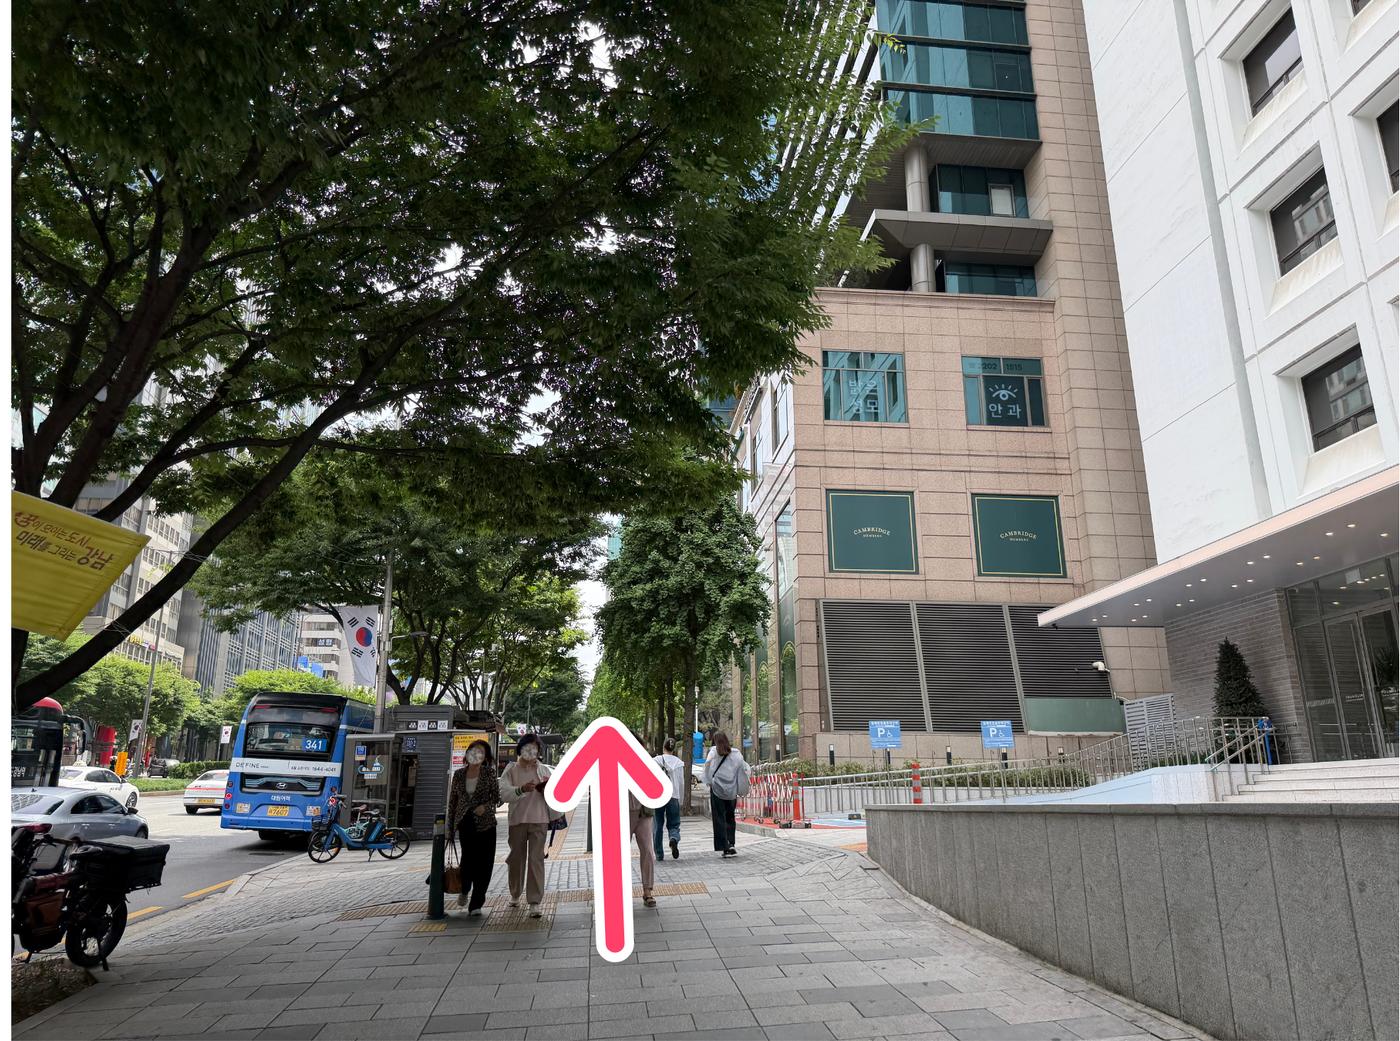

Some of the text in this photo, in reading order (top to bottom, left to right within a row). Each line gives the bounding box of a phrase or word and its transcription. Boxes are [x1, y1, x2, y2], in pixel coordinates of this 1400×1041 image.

[853, 526, 891, 536] CAMBRIDGE
[999, 530, 1037, 540] CAMBRIDGE
[77, 545, 114, 571] 강남
[877, 727, 886, 738] P
[989, 727, 997, 738] P
[305, 740, 322, 750] 341
